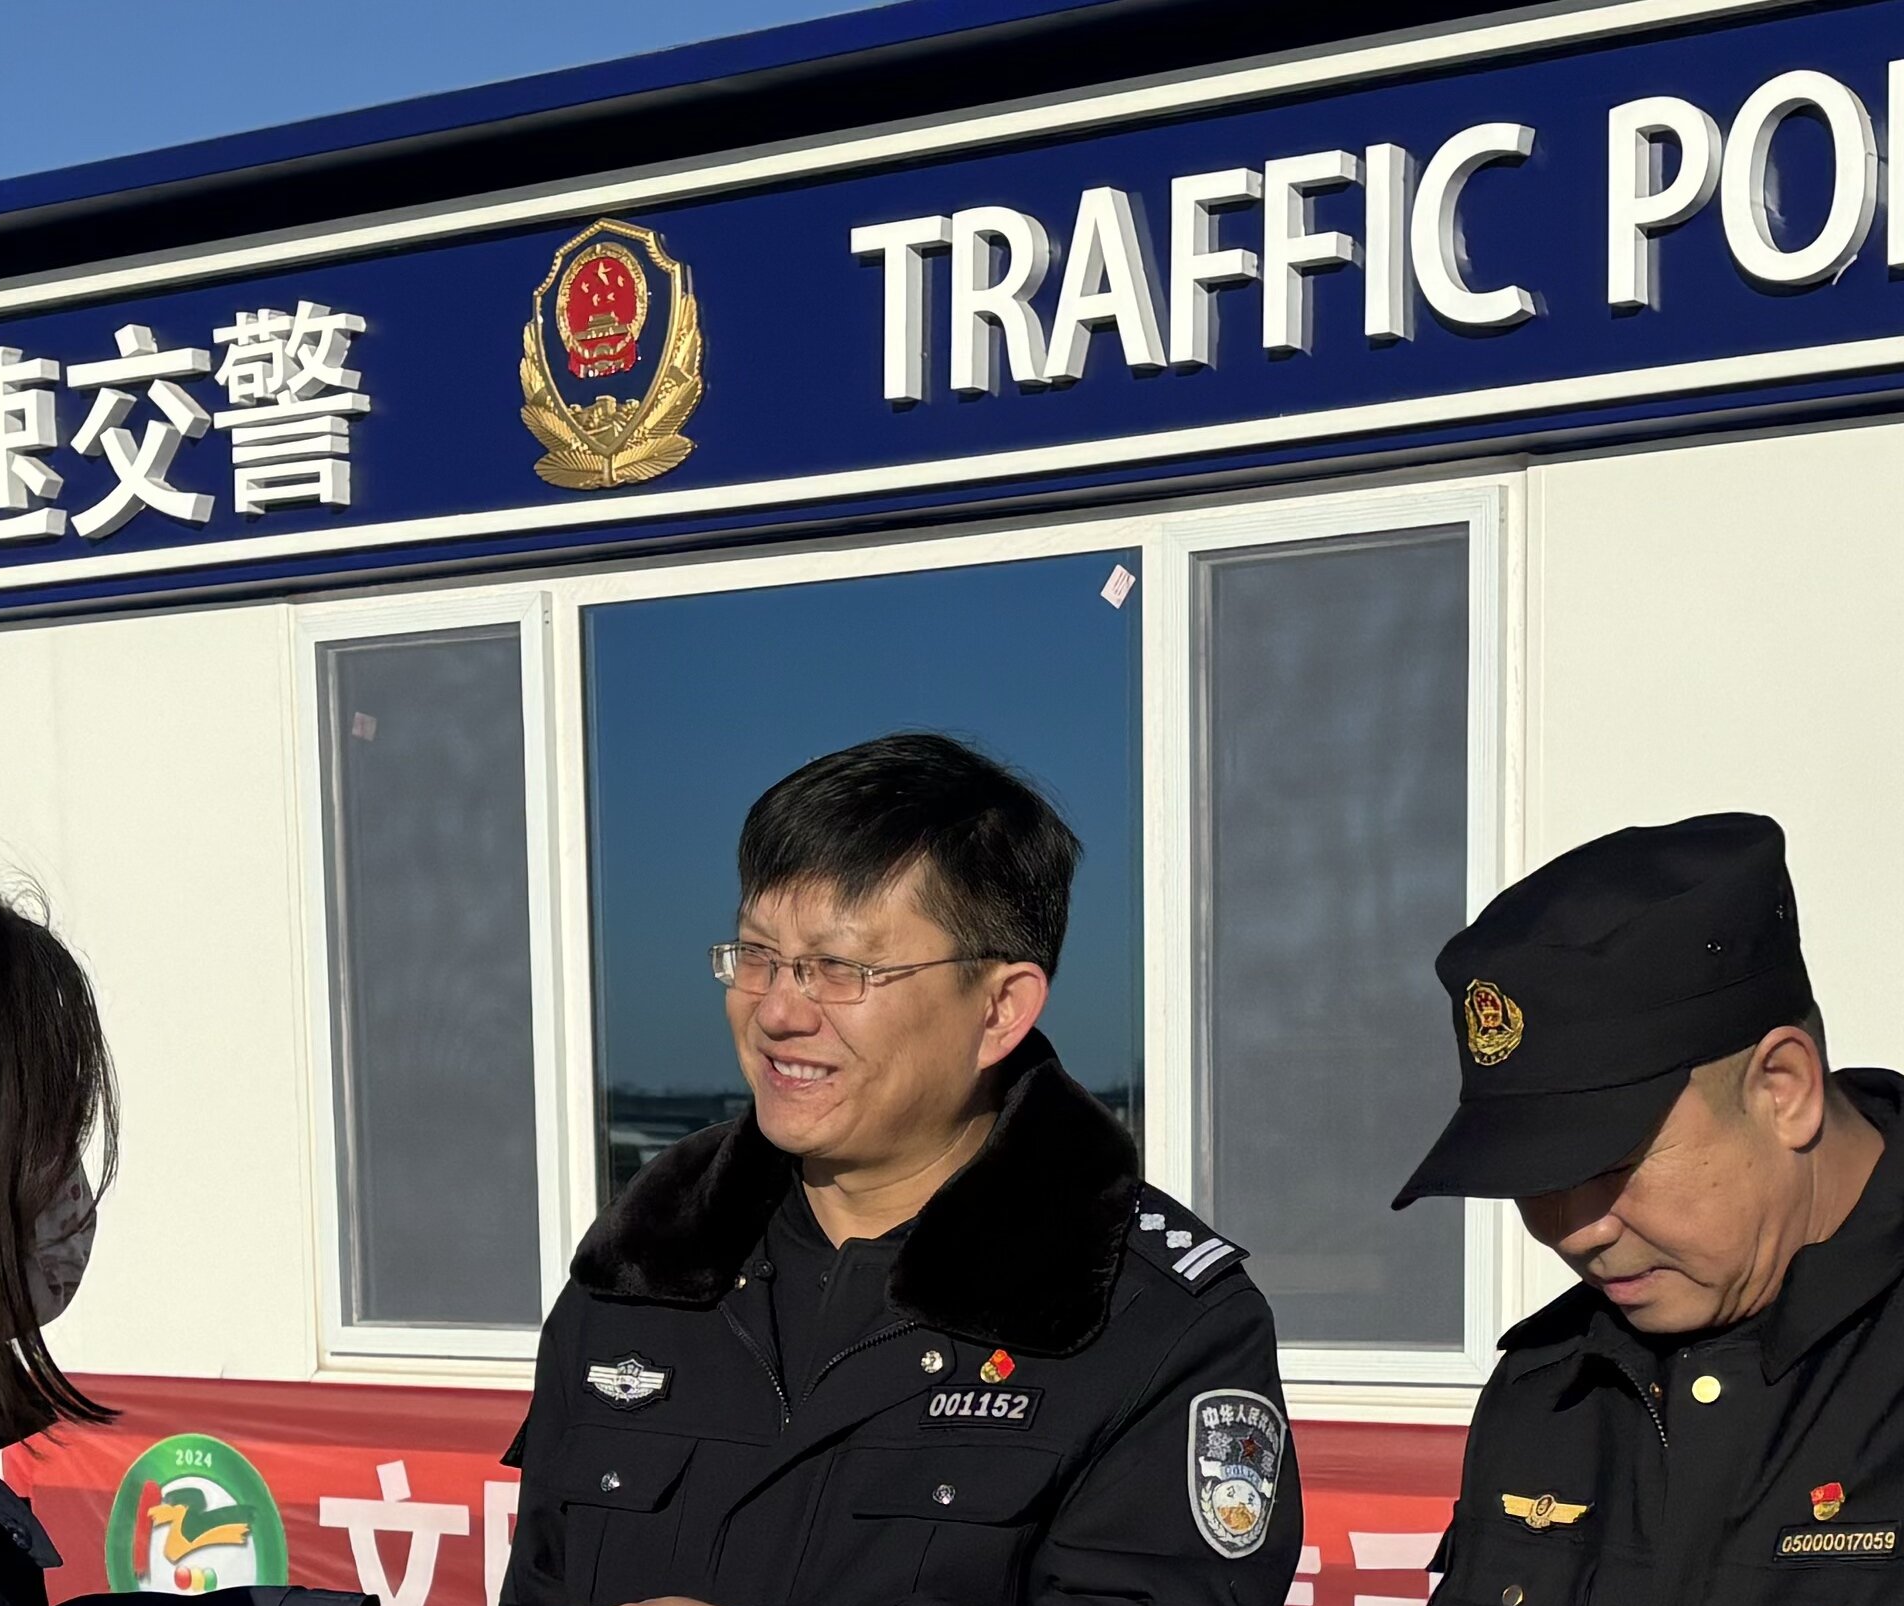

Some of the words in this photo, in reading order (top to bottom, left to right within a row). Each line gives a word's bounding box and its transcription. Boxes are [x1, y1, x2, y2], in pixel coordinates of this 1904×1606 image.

[849, 121, 1536, 405] TRAFFIC
[928, 1391, 1029, 1419] 001152
[175, 1448, 213, 1468] 2024
[1781, 1531, 1896, 1553] 05000017059
